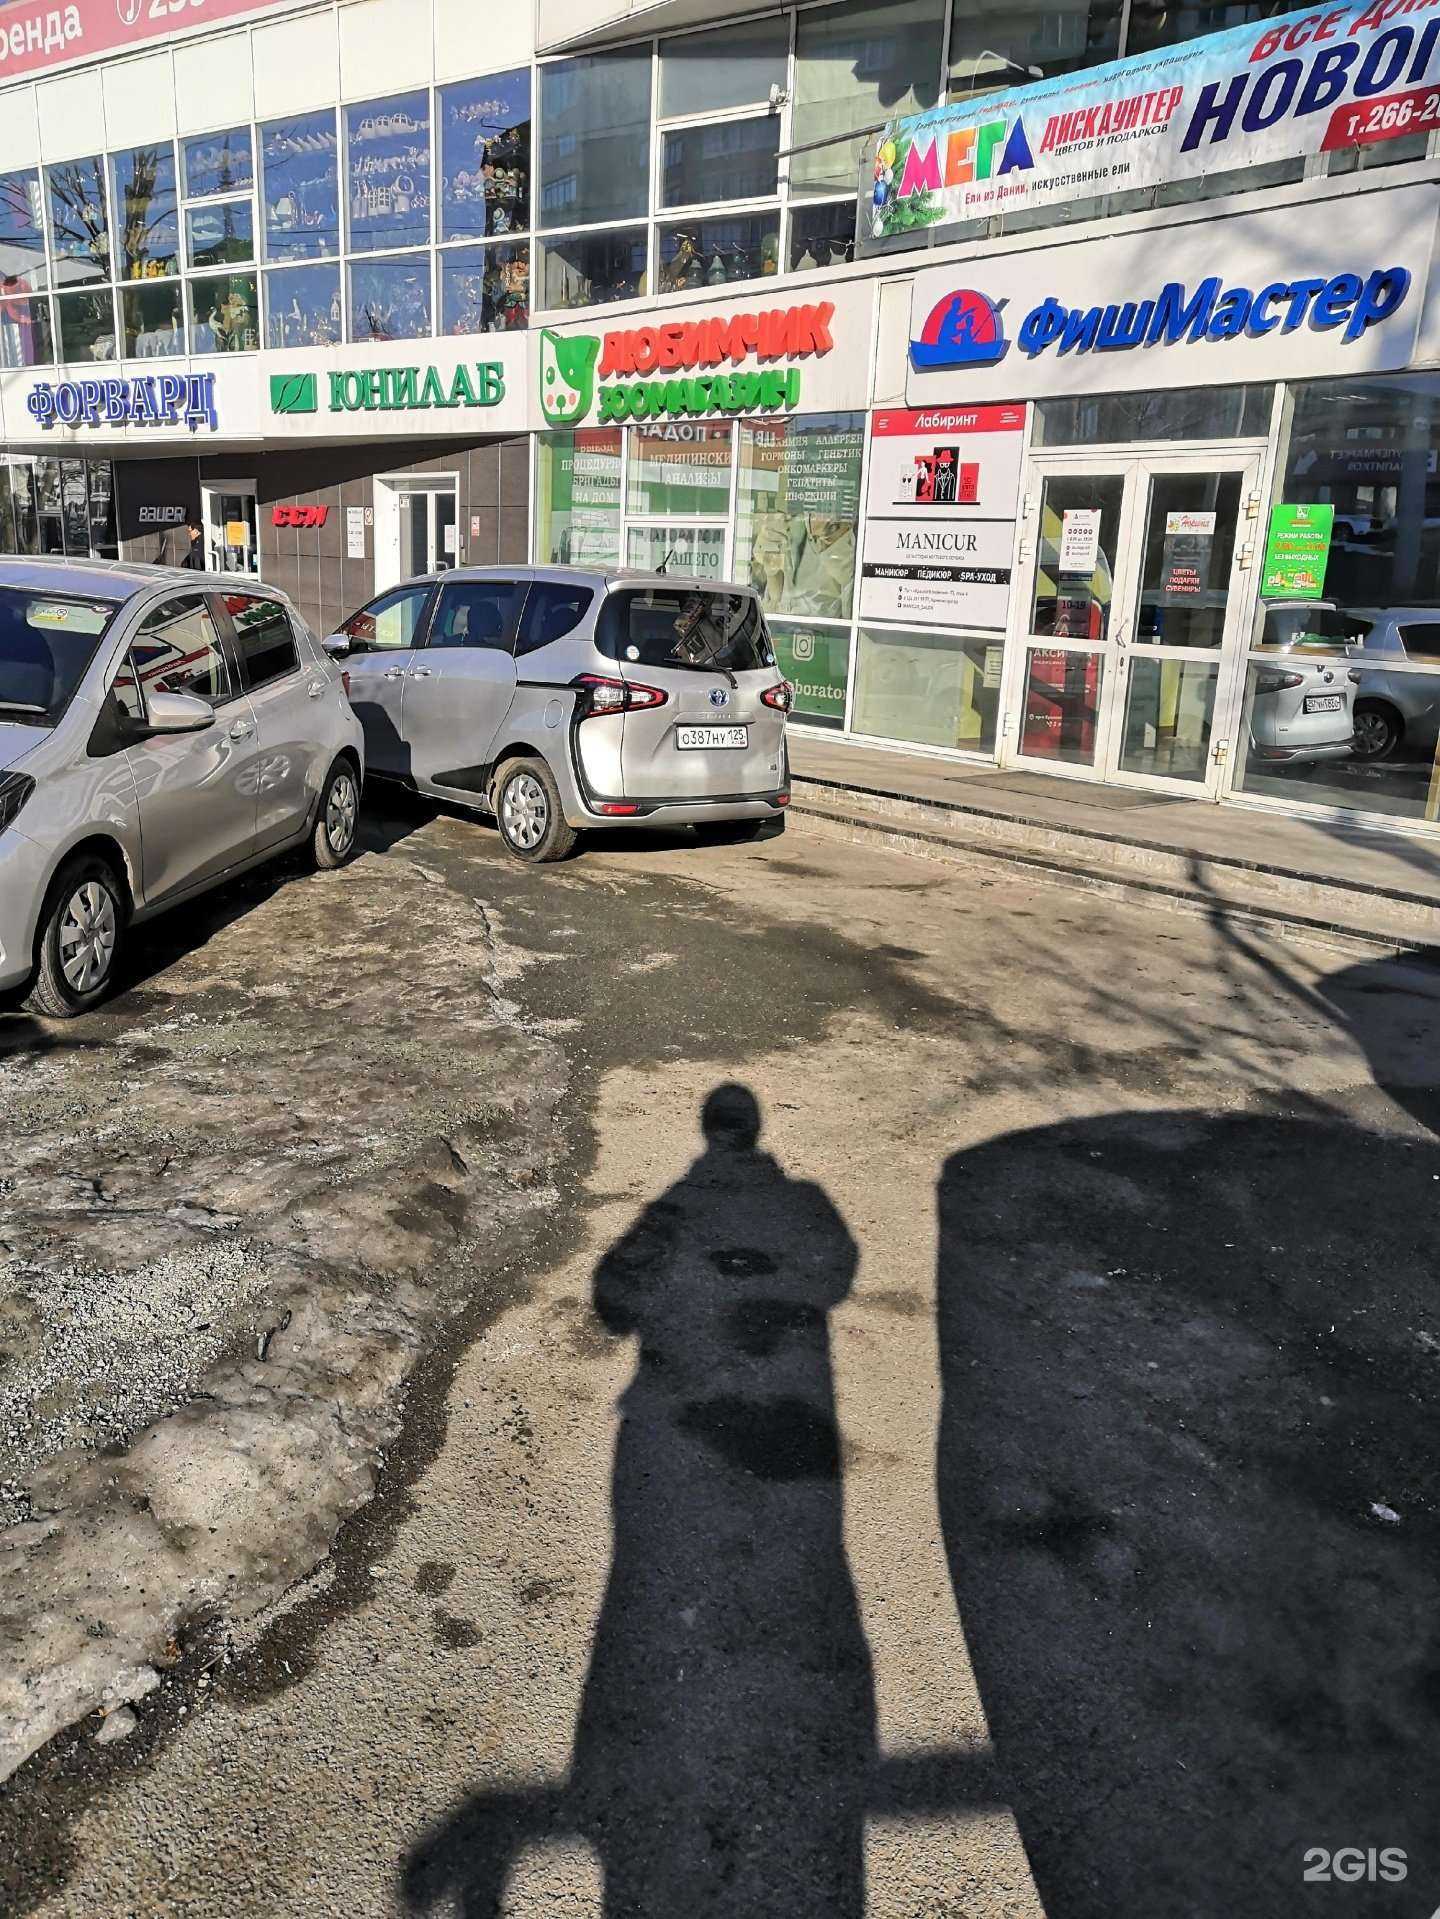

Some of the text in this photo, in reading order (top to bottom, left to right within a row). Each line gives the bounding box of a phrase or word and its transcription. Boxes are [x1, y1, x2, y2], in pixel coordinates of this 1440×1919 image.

[1249, 0, 1440, 62] ВСЕ ДЛ
[1039, 86, 1184, 153] ДИСКАУНТЕР
[1055, 140, 1094, 157] ЦВЕТОВ
[1106, 123, 1168, 145] ПОДАРКОВ
[900, 114, 1035, 197] МЕГА
[965, 192, 981, 205] Ели
[984, 191, 994, 201] из
[1032, 167, 1108, 191] искусственные
[1112, 162, 1130, 177] ели
[1017, 266, 1411, 359] ФишМастер
[598, 301, 835, 379] ЛЮБИМЧИК
[27, 372, 217, 432] ФОРВАРД
[327, 361, 506, 412] ЮНИЛАБ
[598, 368, 802, 424] ЗООМАГАЗИН
[915, 413, 978, 431] Лабиринт
[139, 506, 186, 523] BAUER
[272, 504, 329, 528] CCM
[896, 533, 977, 551] MANICUR
[875, 567, 997, 583] МАНИКЮР ПЕДИКЮР SPA-УХОД
[682, 729, 744, 745] О387НУ 125
